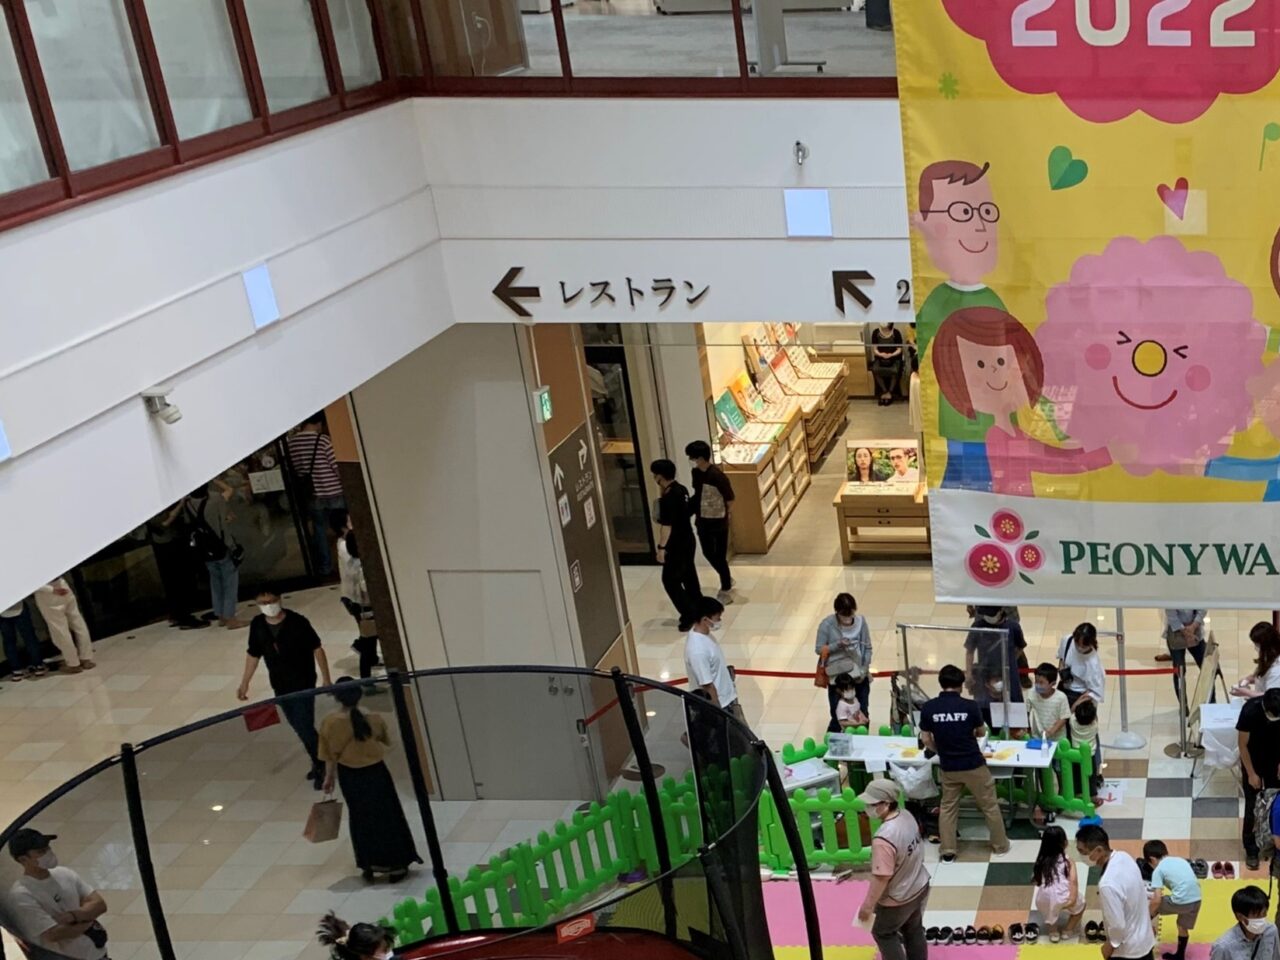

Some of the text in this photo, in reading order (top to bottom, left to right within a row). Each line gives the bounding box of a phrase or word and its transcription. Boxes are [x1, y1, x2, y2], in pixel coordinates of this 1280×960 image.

[1010, 0, 1256, 47] 2022
[559, 277, 710, 310] レストラン
[932, 712, 968, 722] STAFF
